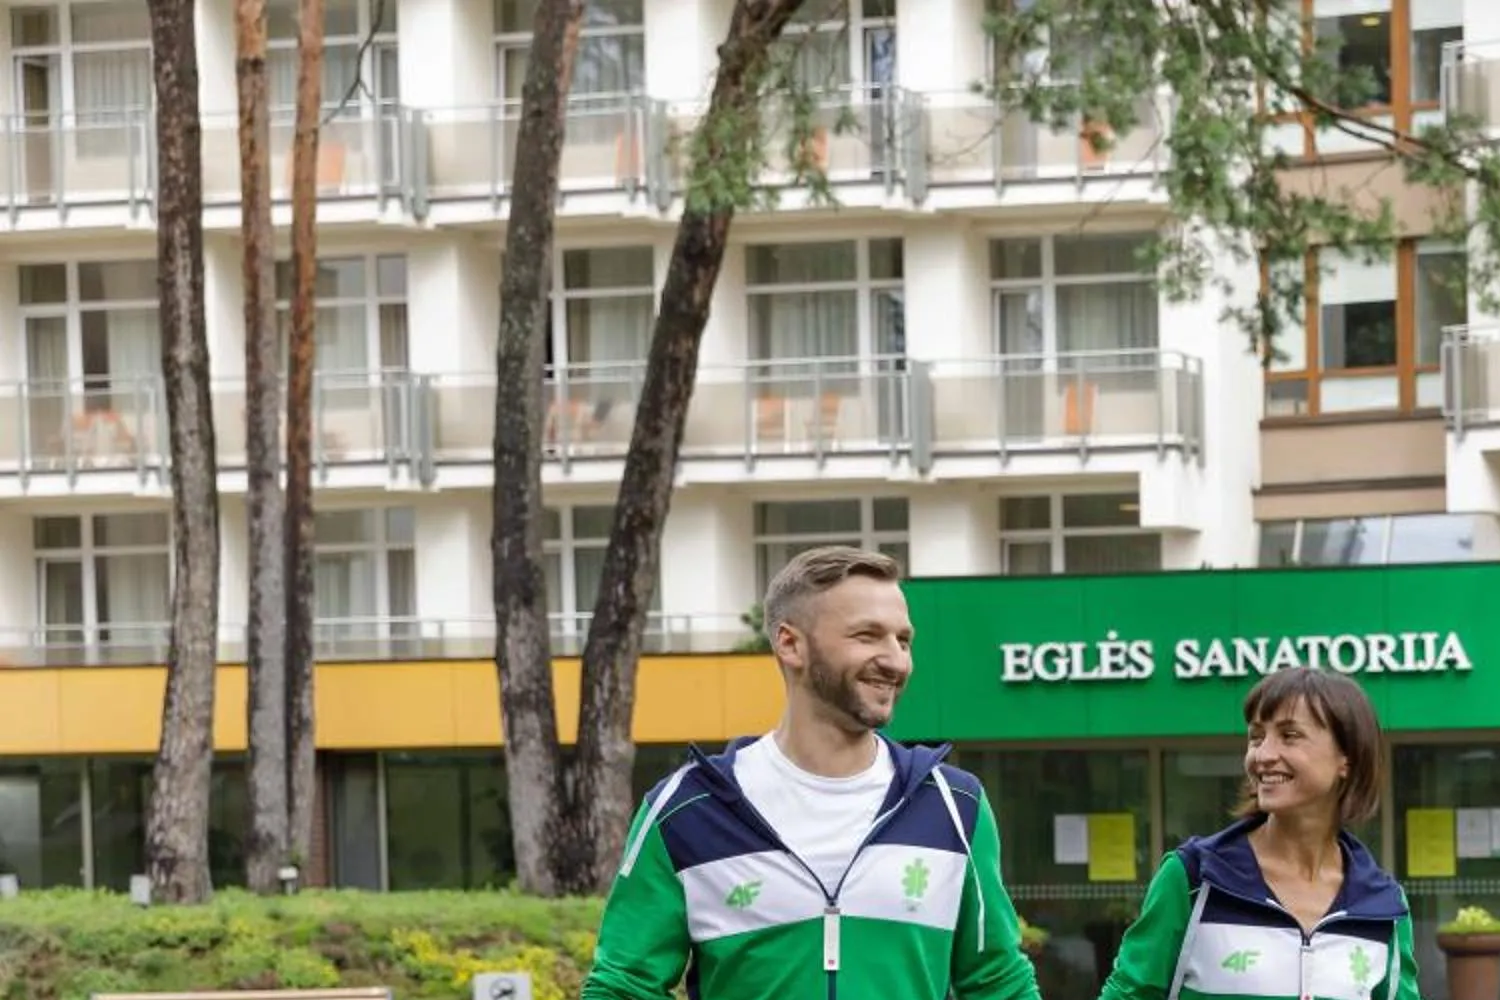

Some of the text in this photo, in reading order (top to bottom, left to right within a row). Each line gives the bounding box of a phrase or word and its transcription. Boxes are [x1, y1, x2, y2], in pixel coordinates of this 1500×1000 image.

[1000, 630, 1473, 682] EGLĖS SANATORIJA
[1221, 949, 1263, 974] 4F
